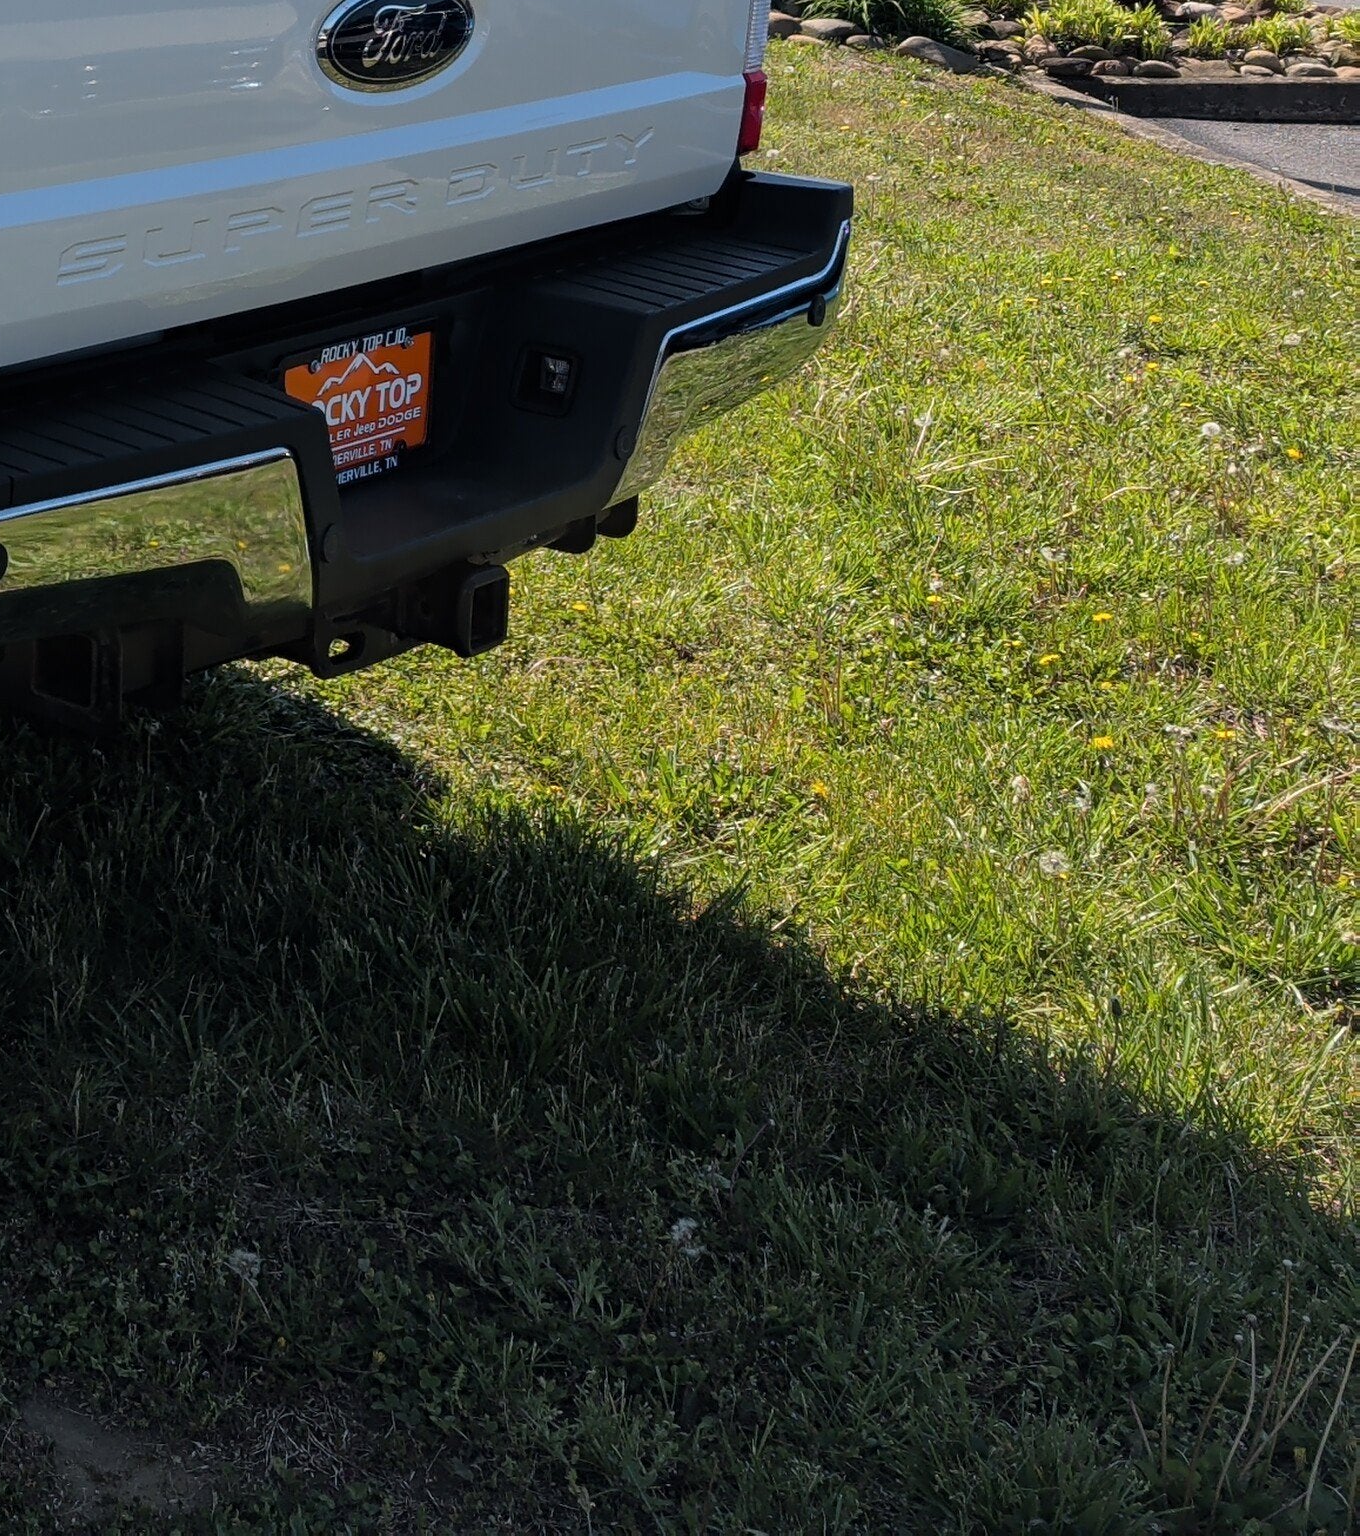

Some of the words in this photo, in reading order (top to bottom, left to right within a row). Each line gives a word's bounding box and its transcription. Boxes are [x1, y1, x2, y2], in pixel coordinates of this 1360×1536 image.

[362, 3, 448, 68] Ford
[56, 179, 419, 287] SUPER
[445, 126, 656, 206] DUTY
[320, 339, 360, 364] ROCKY
[362, 333, 384, 353] TOP
[312, 386, 372, 426] CKY
[375, 373, 422, 412] TOP
[354, 421, 376, 437] Jeep
[378, 406, 422, 428] DODGE
[333, 444, 377, 466] IERVILLE,
[380, 438, 393, 452] TN
[336, 460, 383, 485] IERVILLE,
[385, 455, 399, 470] TN
